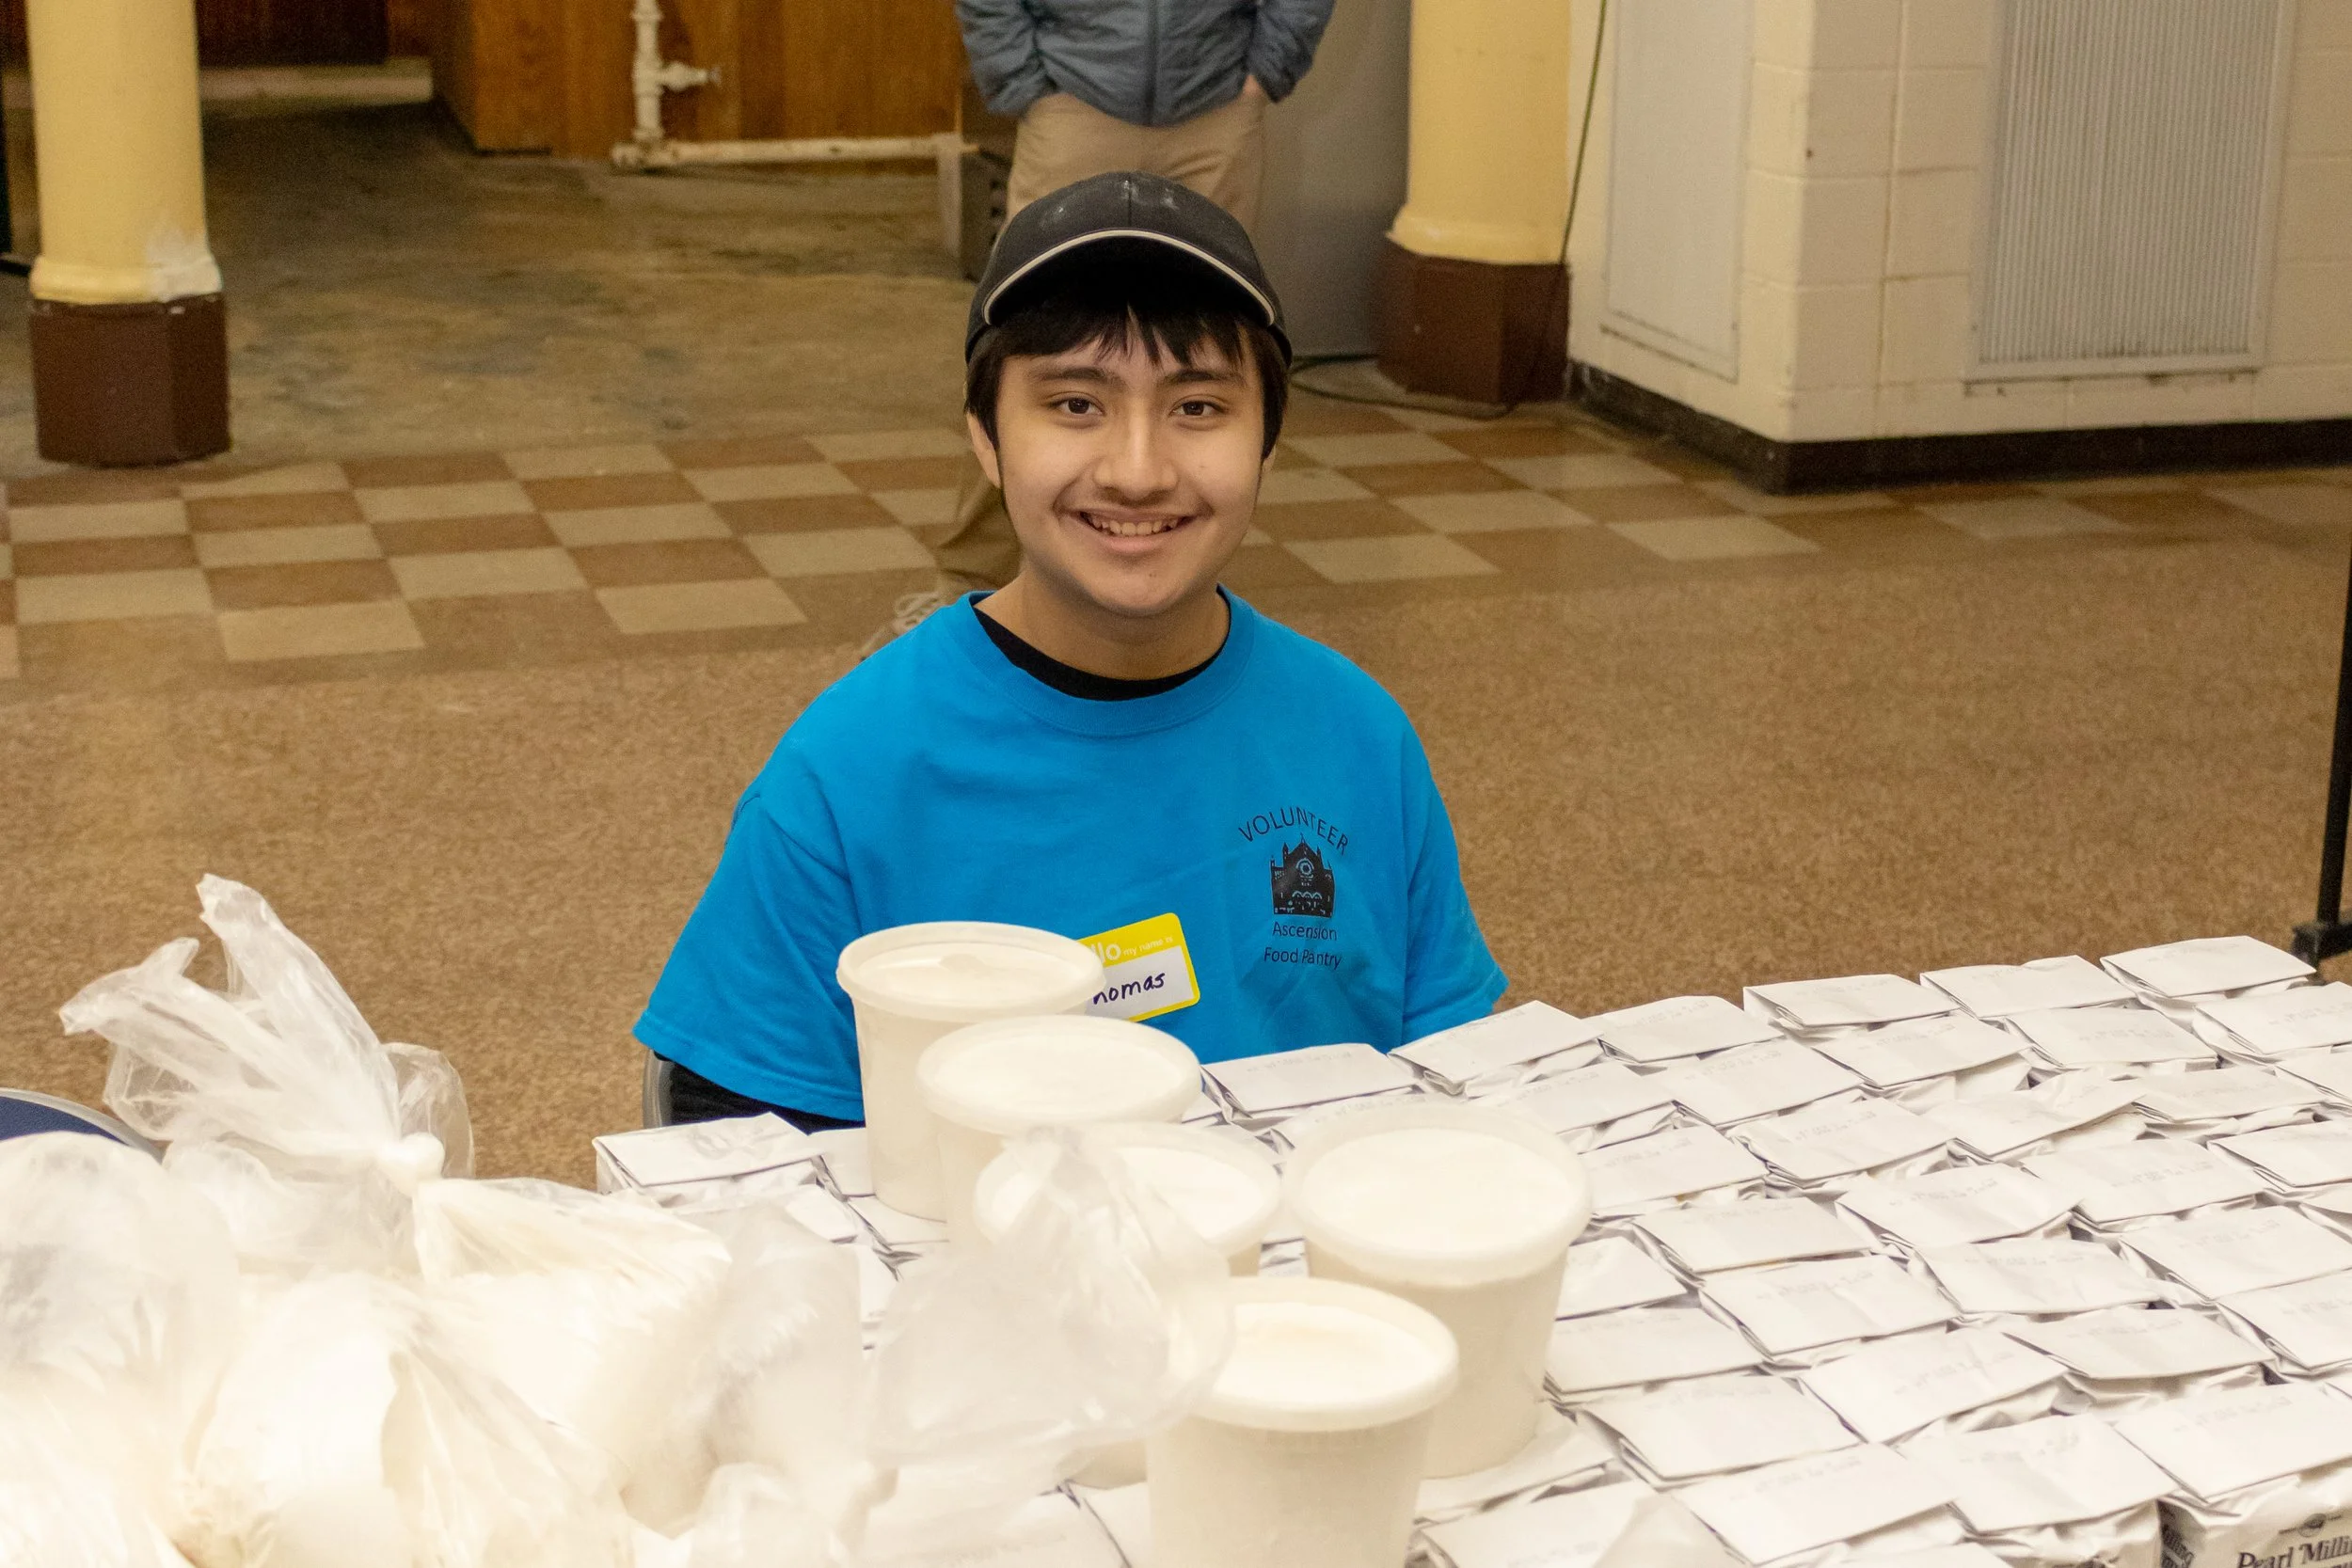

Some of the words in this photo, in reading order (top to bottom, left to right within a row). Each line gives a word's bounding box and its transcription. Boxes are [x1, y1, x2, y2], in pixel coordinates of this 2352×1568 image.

[1238, 806, 1348, 856] VOLUNTEER
[1272, 921, 1338, 941] Ascension
[1263, 946, 1298, 963] Food
[1302, 948, 1343, 971] Pantry
